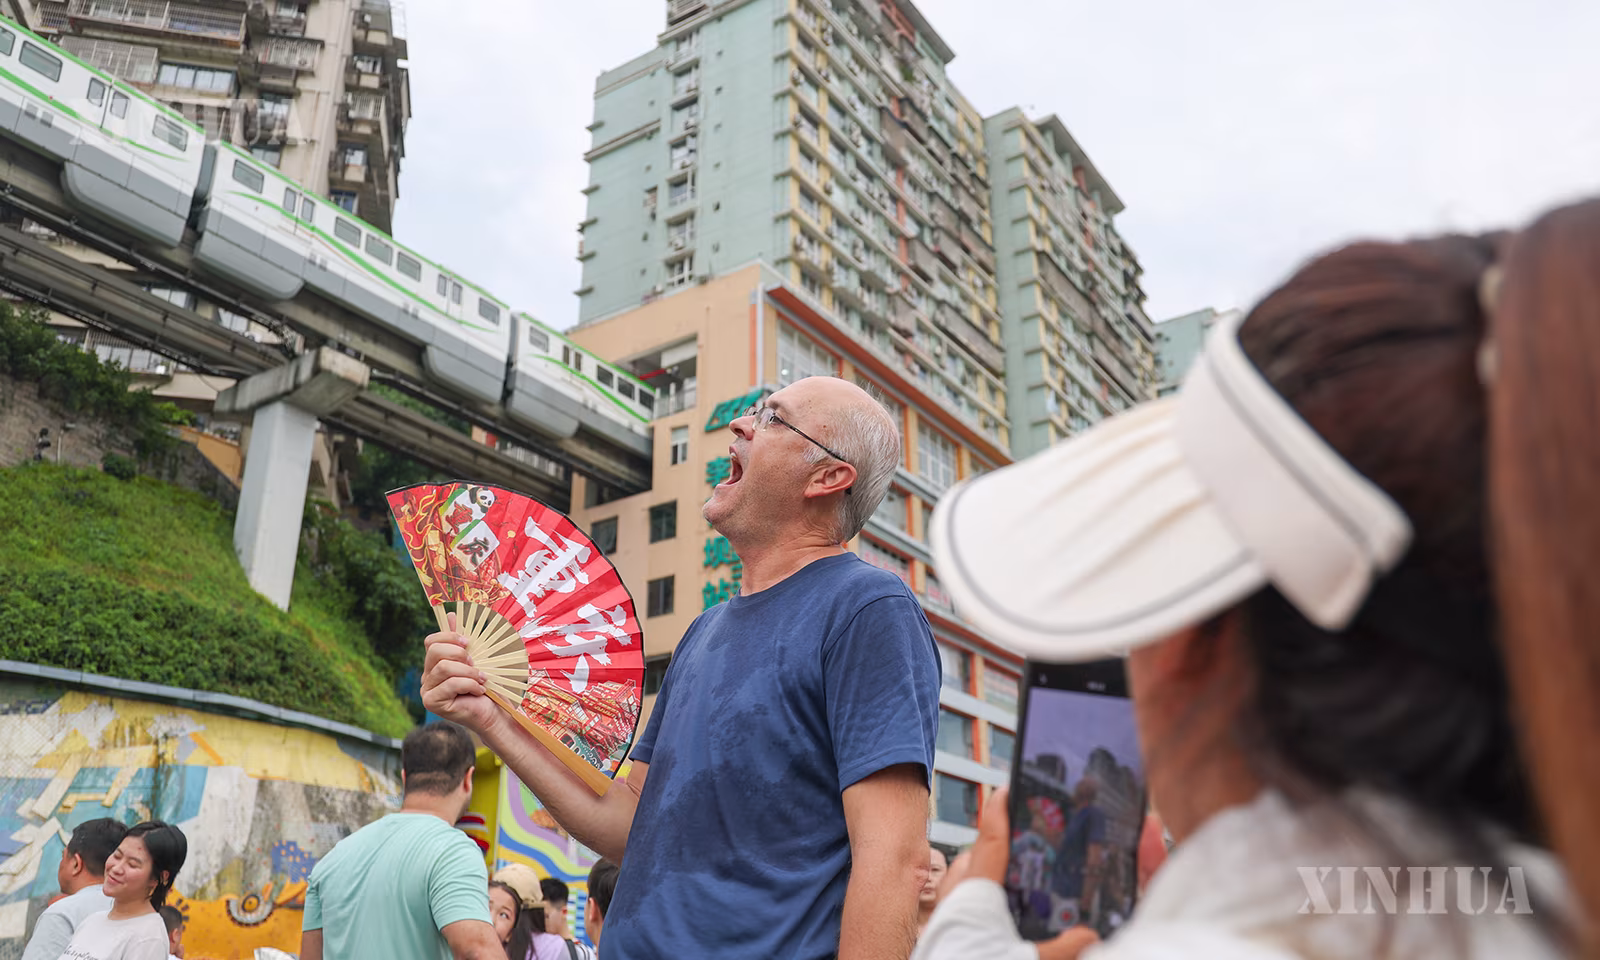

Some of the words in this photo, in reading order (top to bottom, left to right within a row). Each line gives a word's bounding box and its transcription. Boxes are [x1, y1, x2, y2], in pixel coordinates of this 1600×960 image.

[497, 516, 632, 694] 重庆
[702, 456, 731, 613] 李坝站
